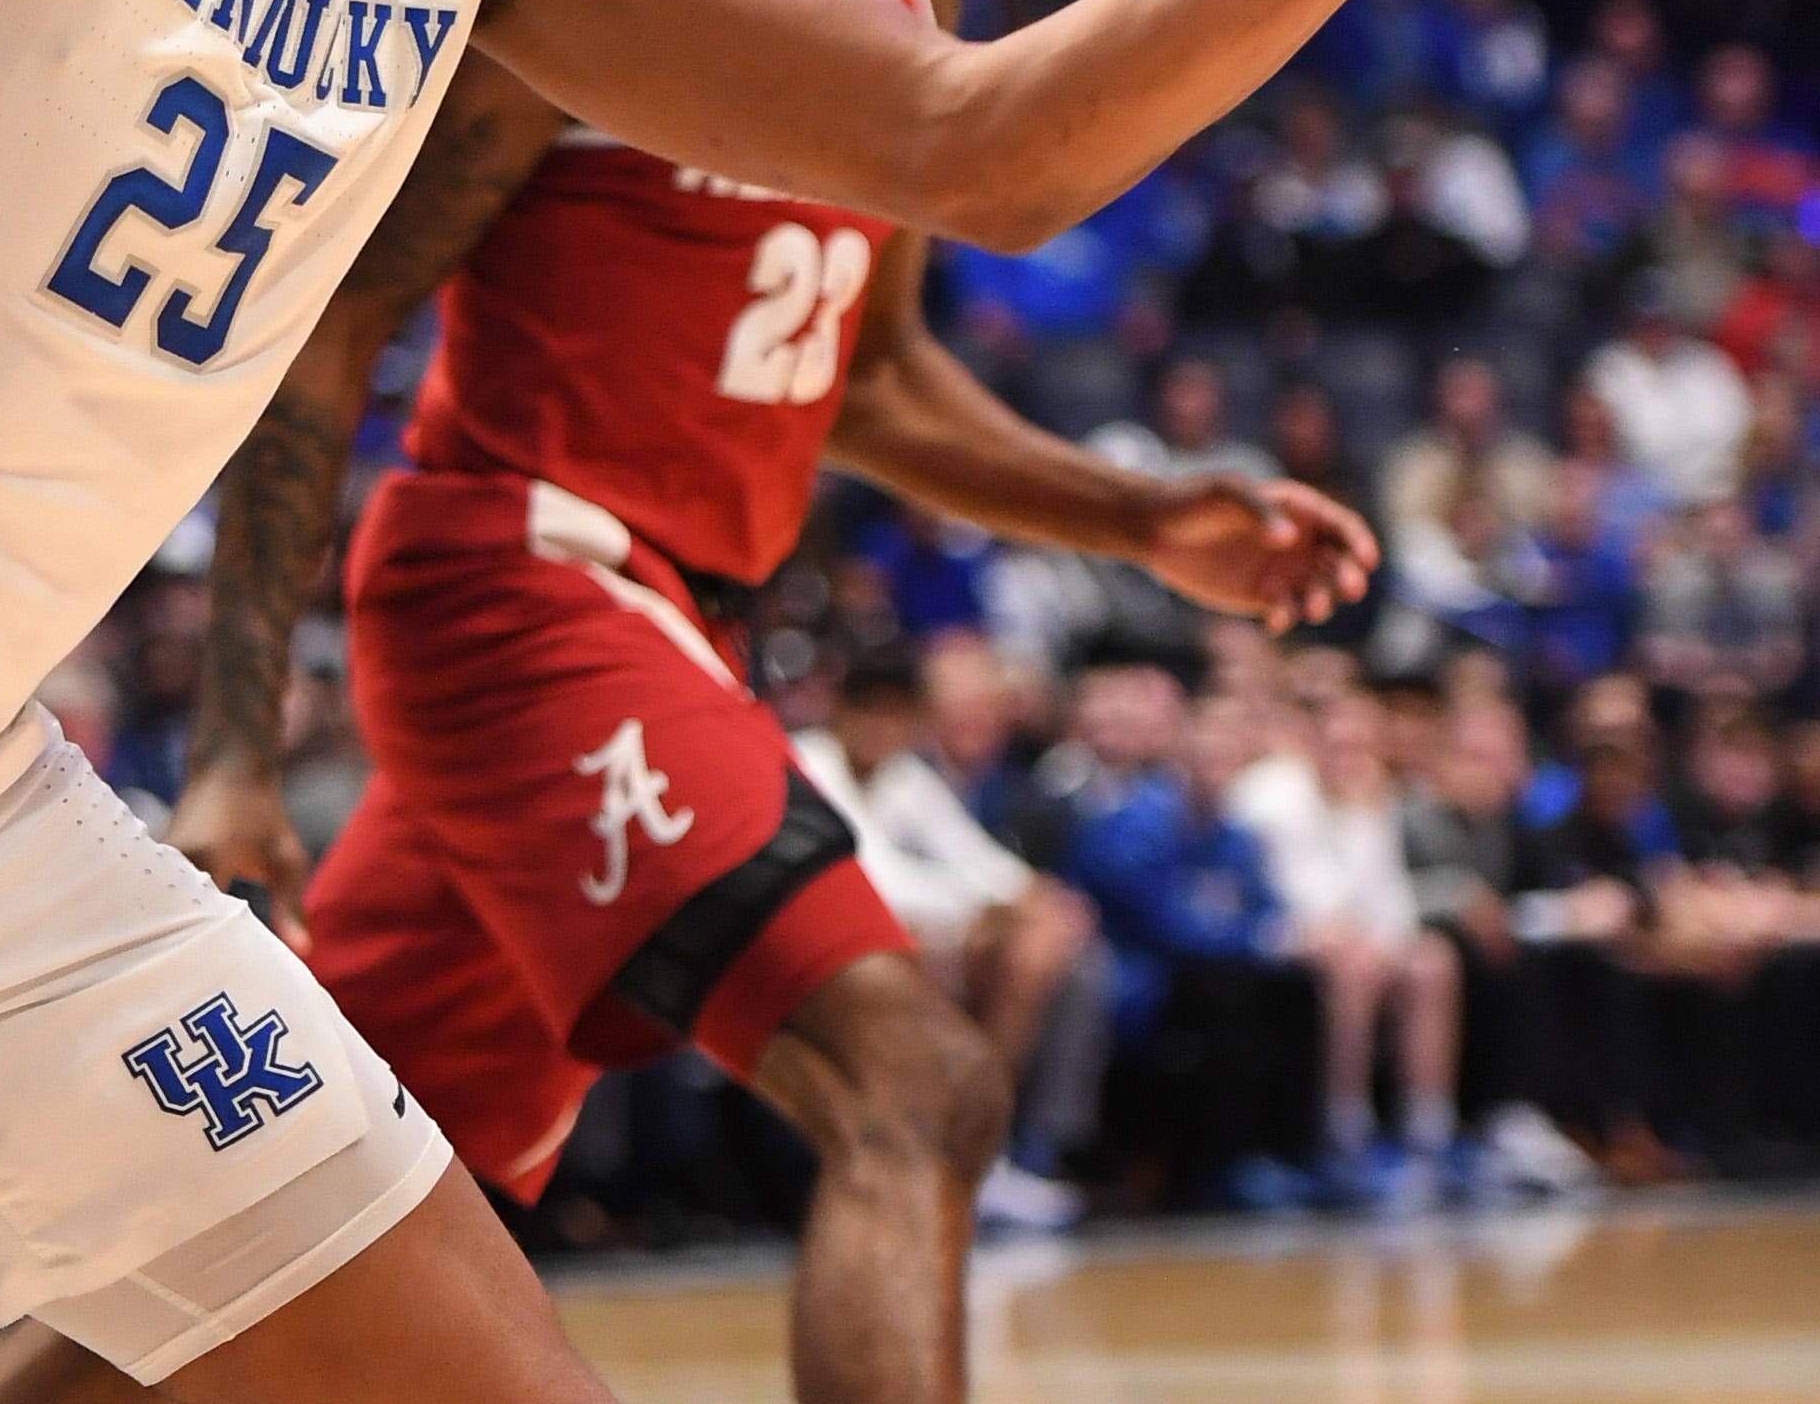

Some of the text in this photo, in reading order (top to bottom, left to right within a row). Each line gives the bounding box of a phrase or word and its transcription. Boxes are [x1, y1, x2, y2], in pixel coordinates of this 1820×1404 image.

[44, 74, 341, 367] 25
[717, 220, 872, 406] 23
[571, 716, 696, 908] A
[121, 990, 325, 1152] UK
